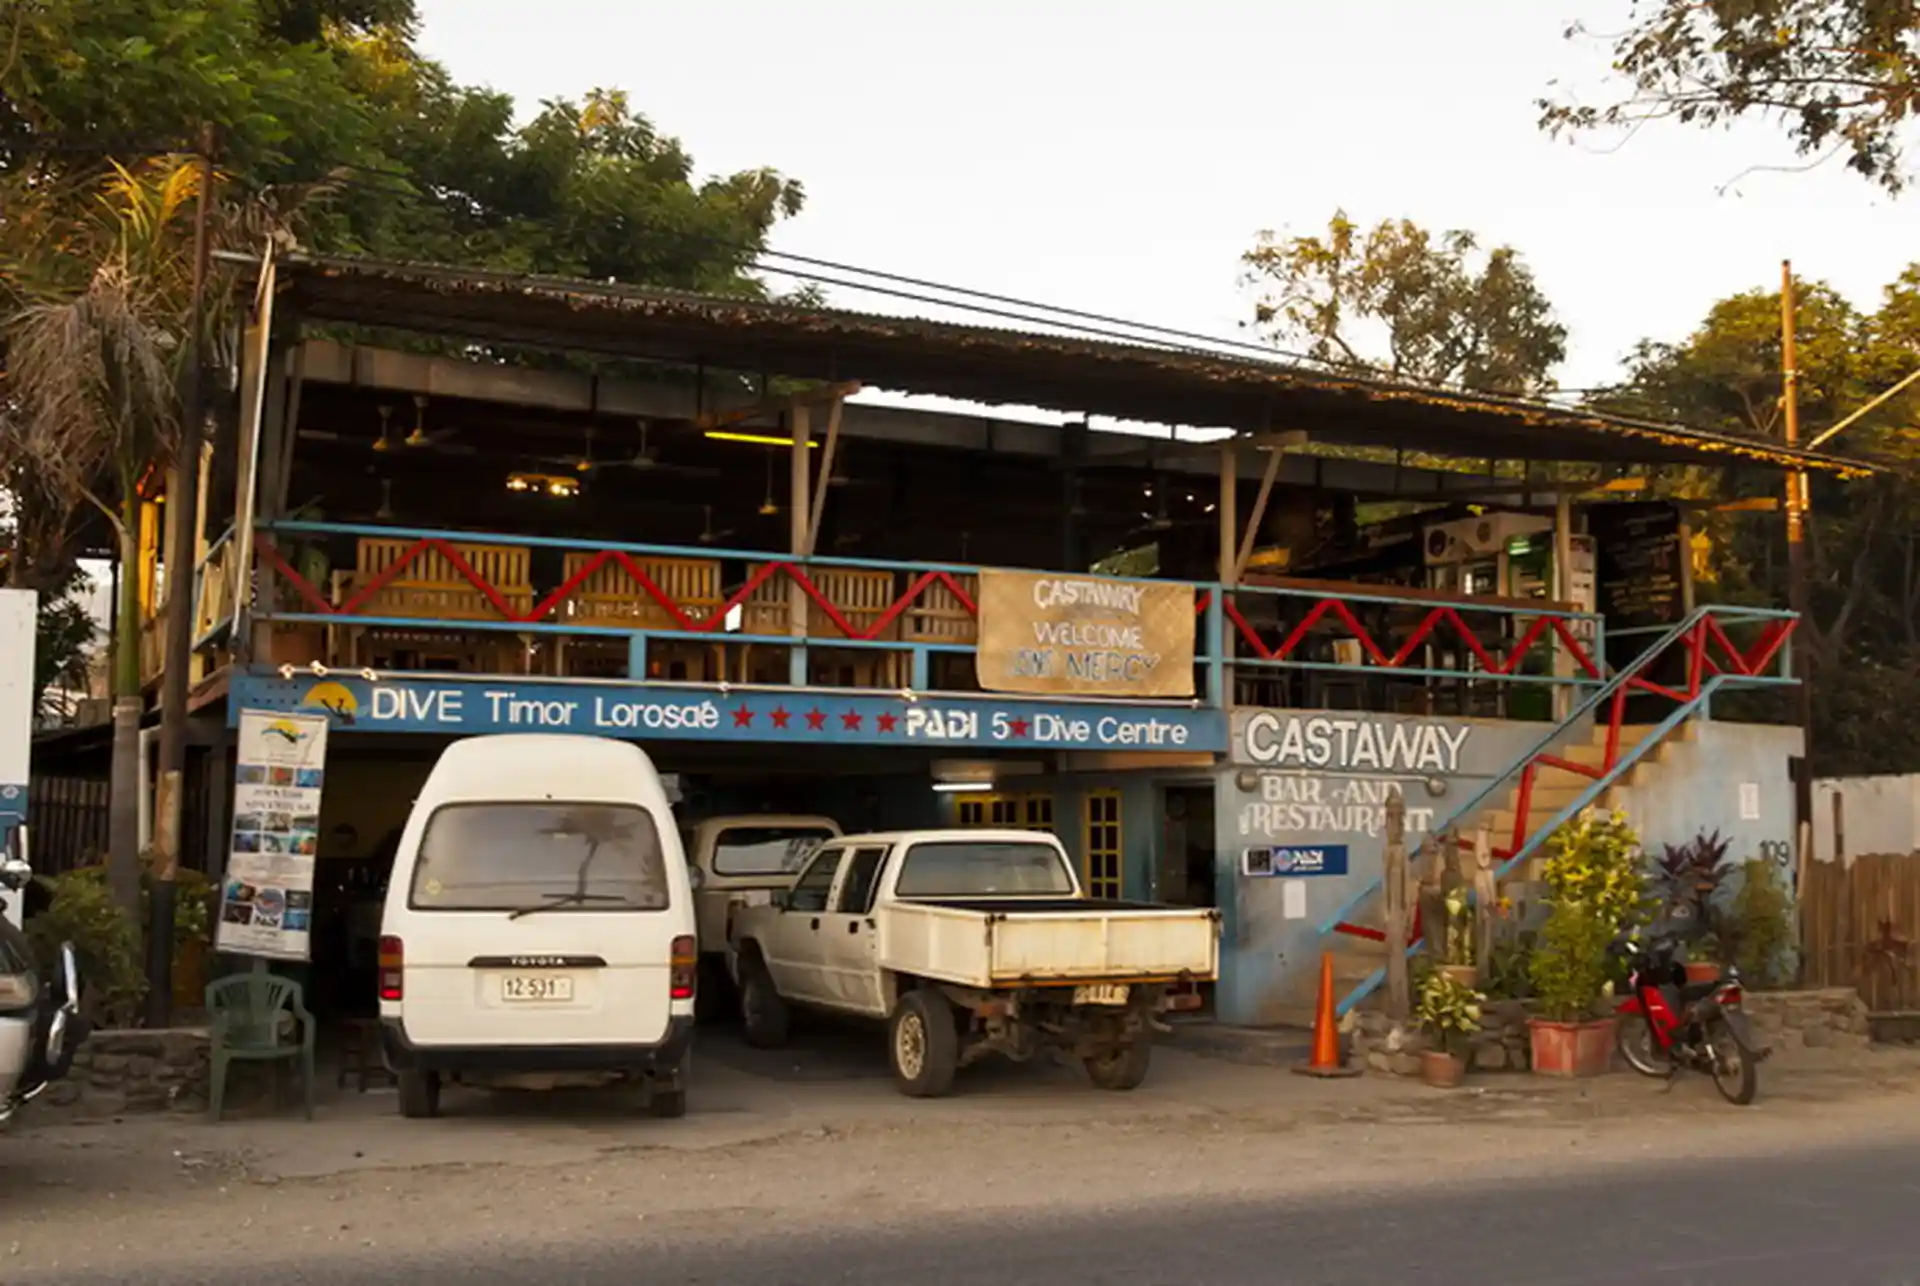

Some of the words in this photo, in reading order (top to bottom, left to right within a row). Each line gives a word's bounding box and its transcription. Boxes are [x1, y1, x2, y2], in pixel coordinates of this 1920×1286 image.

[1034, 579, 1148, 615] CASTAWAY
[1033, 621, 1144, 649] WELCOME
[371, 687, 464, 721] DIVE
[485, 691, 577, 725] Timor
[594, 696, 719, 729] Lorosaé
[906, 708, 977, 739] PADI
[991, 712, 1010, 740] 5
[1033, 715, 1089, 742] Dive
[1097, 717, 1188, 744] Centre
[1247, 712, 1470, 771] CASTAWAY
[1261, 776, 1322, 804] BAR
[511, 956, 566, 966] TOYOTA
